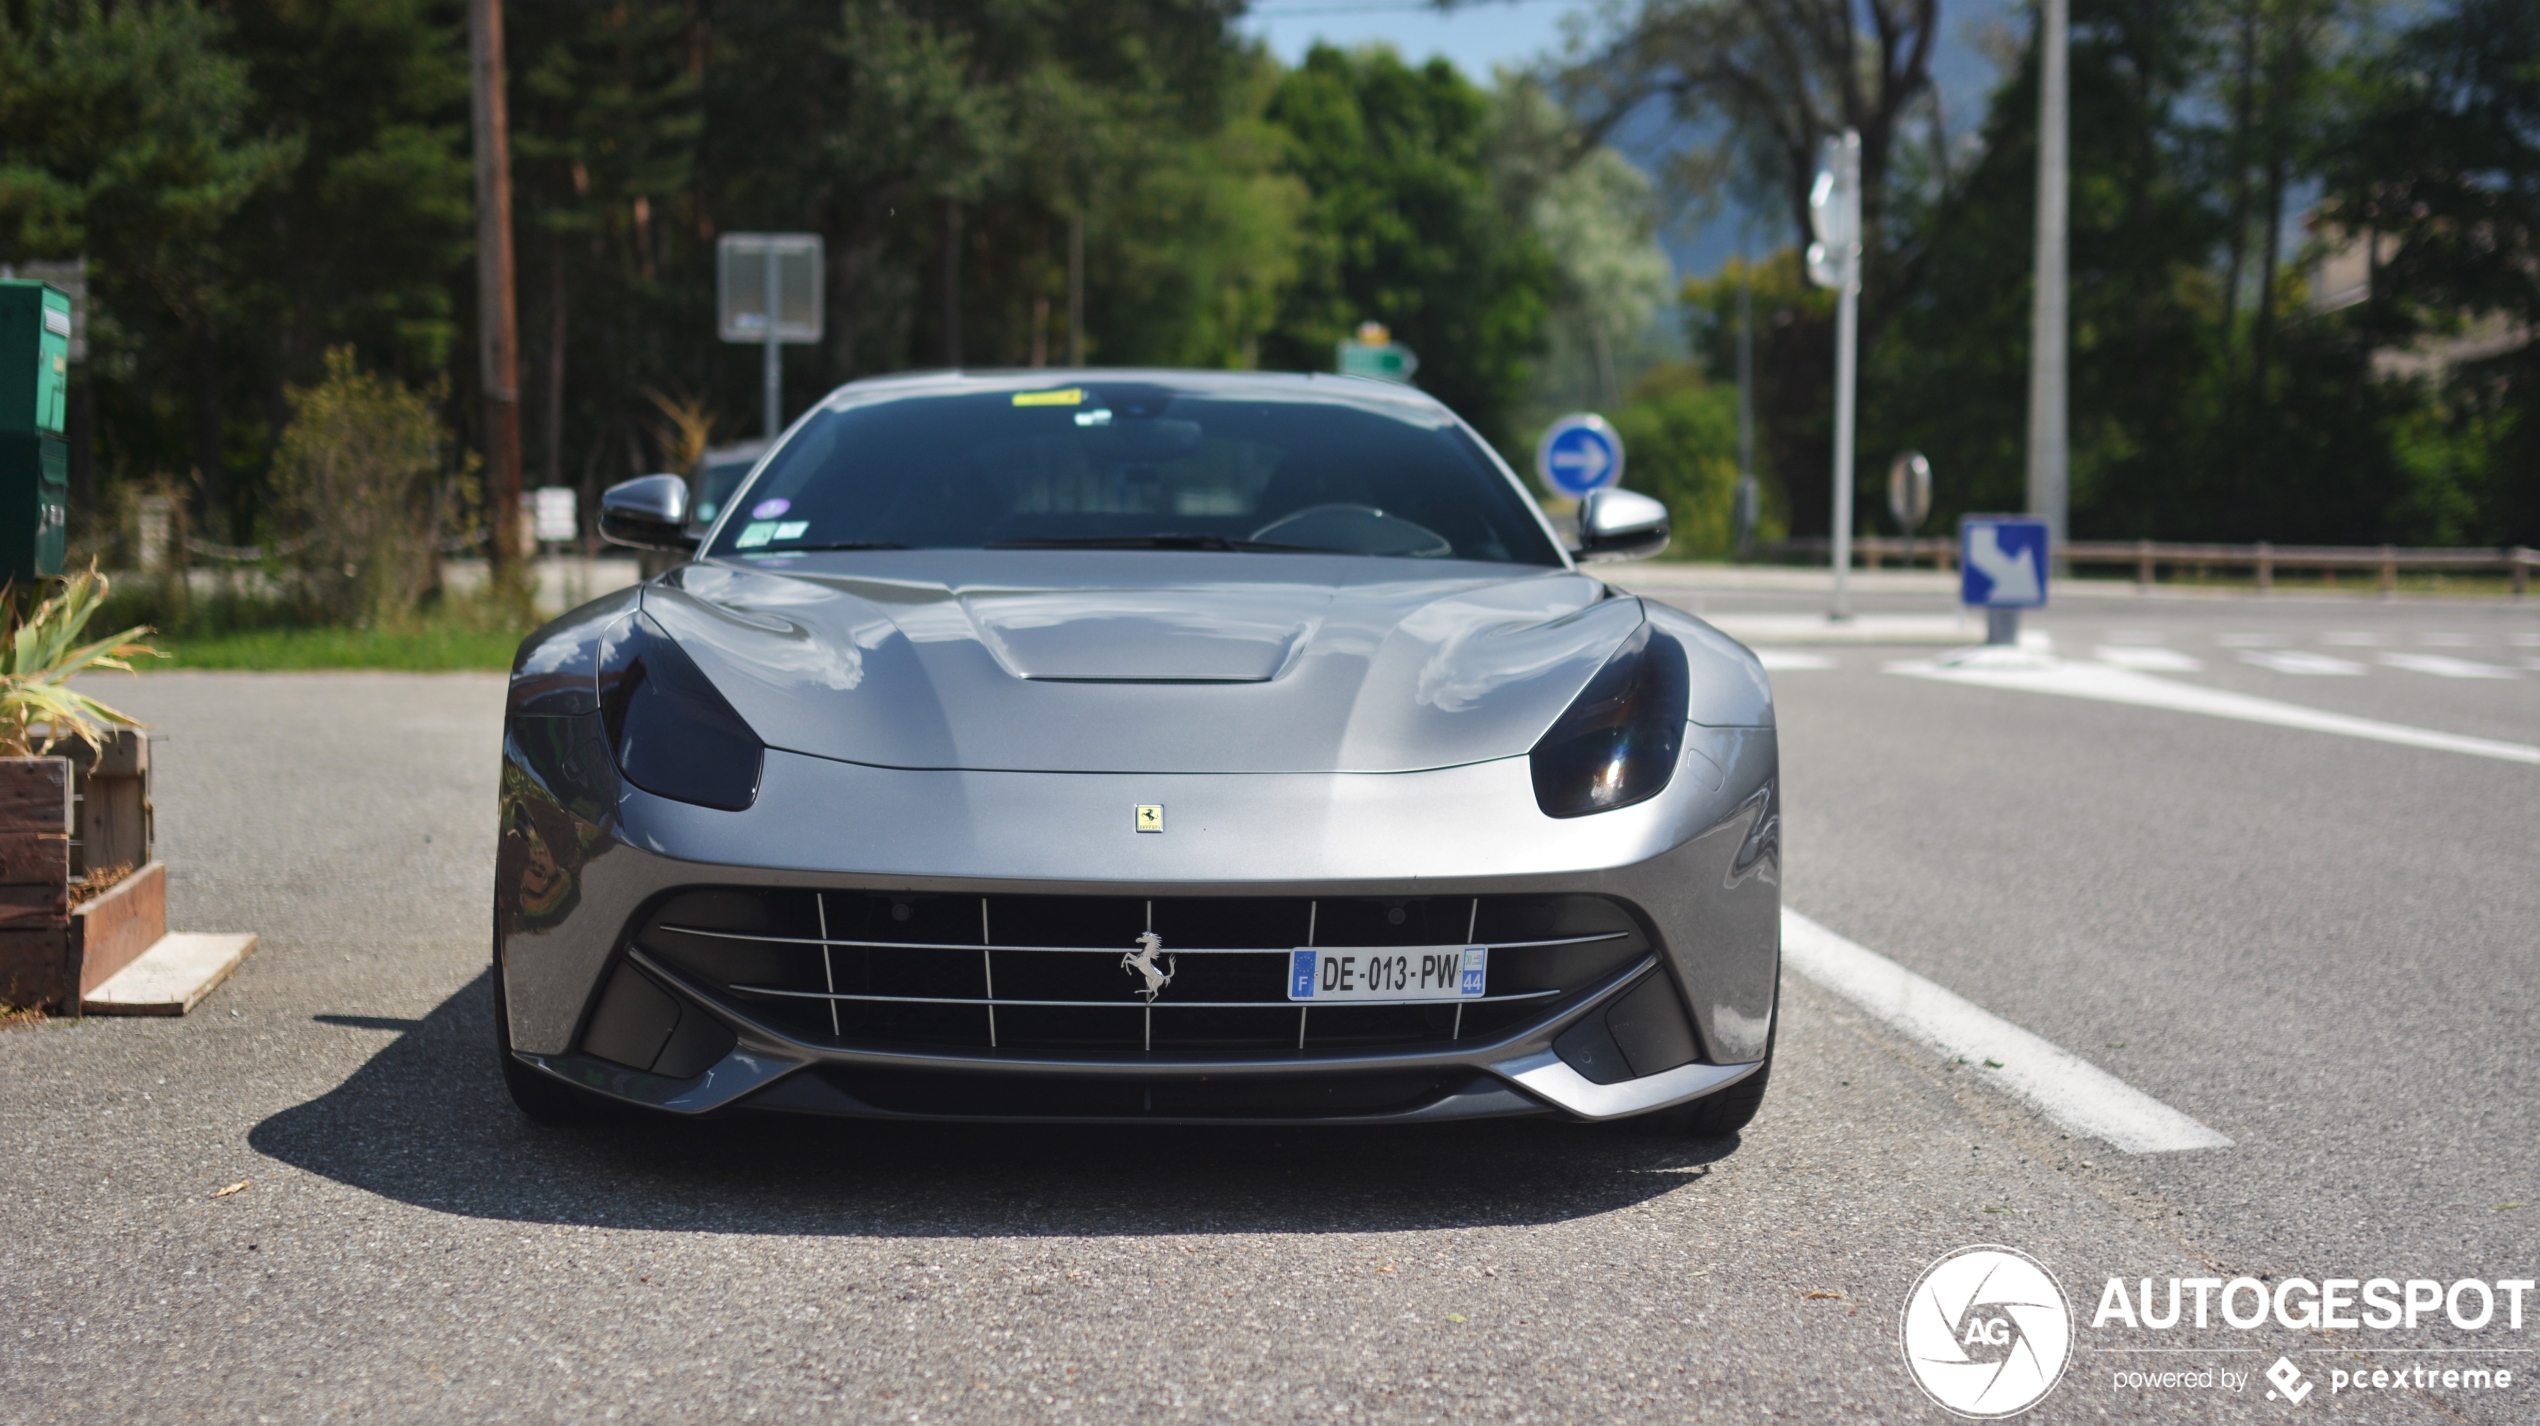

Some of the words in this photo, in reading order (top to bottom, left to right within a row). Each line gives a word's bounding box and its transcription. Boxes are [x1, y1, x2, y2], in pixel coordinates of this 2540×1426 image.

[1322, 954, 1459, 991] DE-013-PW
[1298, 976, 1309, 991] F
[1463, 973, 1482, 991] 44
